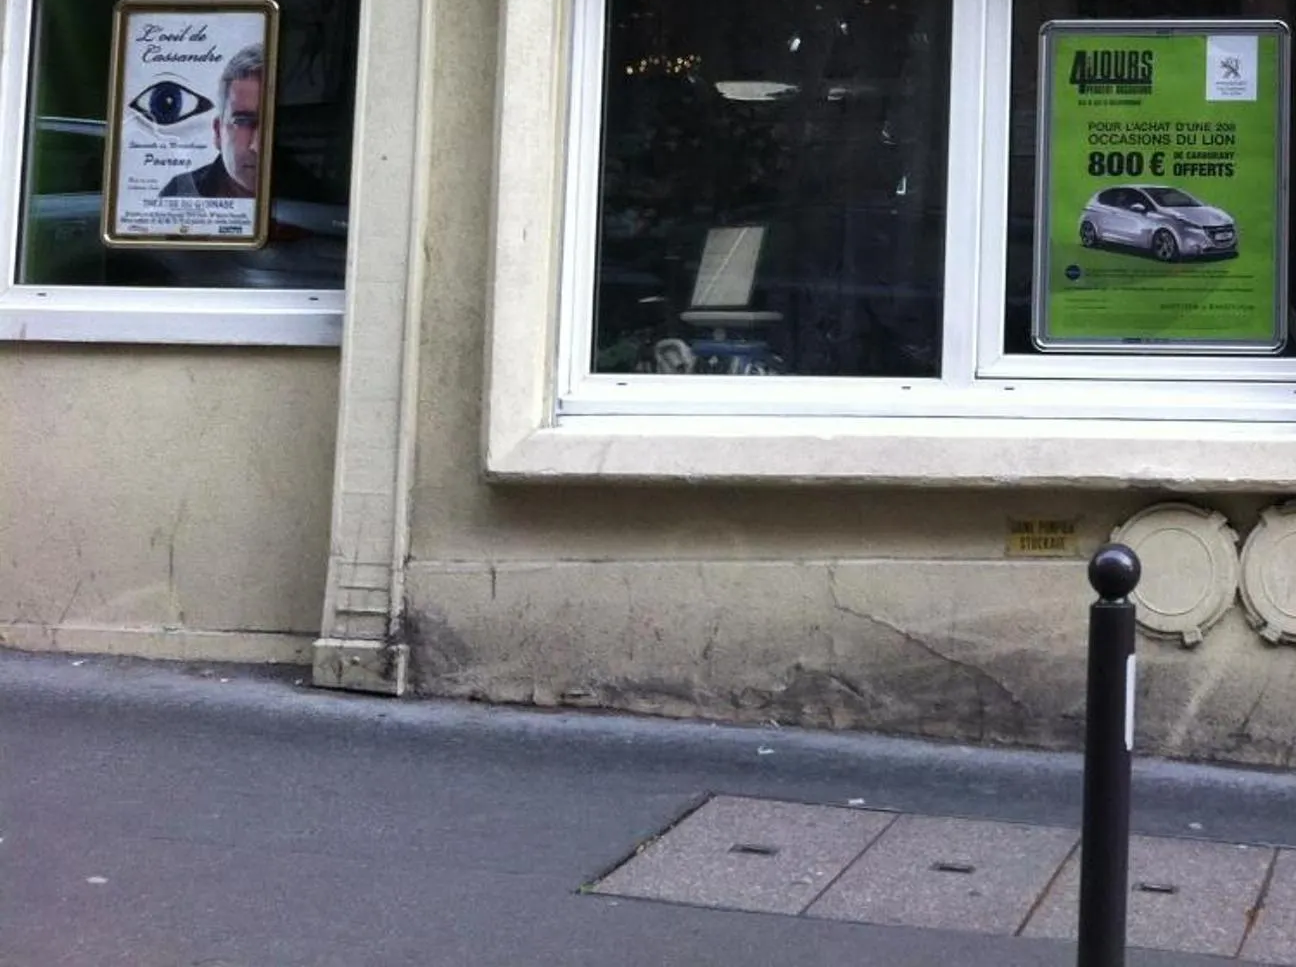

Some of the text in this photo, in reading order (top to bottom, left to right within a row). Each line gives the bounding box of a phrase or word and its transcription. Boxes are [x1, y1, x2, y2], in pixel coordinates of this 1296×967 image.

[142, 44, 223, 64] Cassandre
[1088, 122, 1121, 132] POUR
[1125, 122, 1170, 133] L'ACHAT
[1175, 122, 1212, 133] D'UNE
[1088, 133, 1236, 146] OCCASIONS DU LION
[1088, 151, 1165, 177] 800 €
[1173, 163, 1235, 177] OFFERTS
